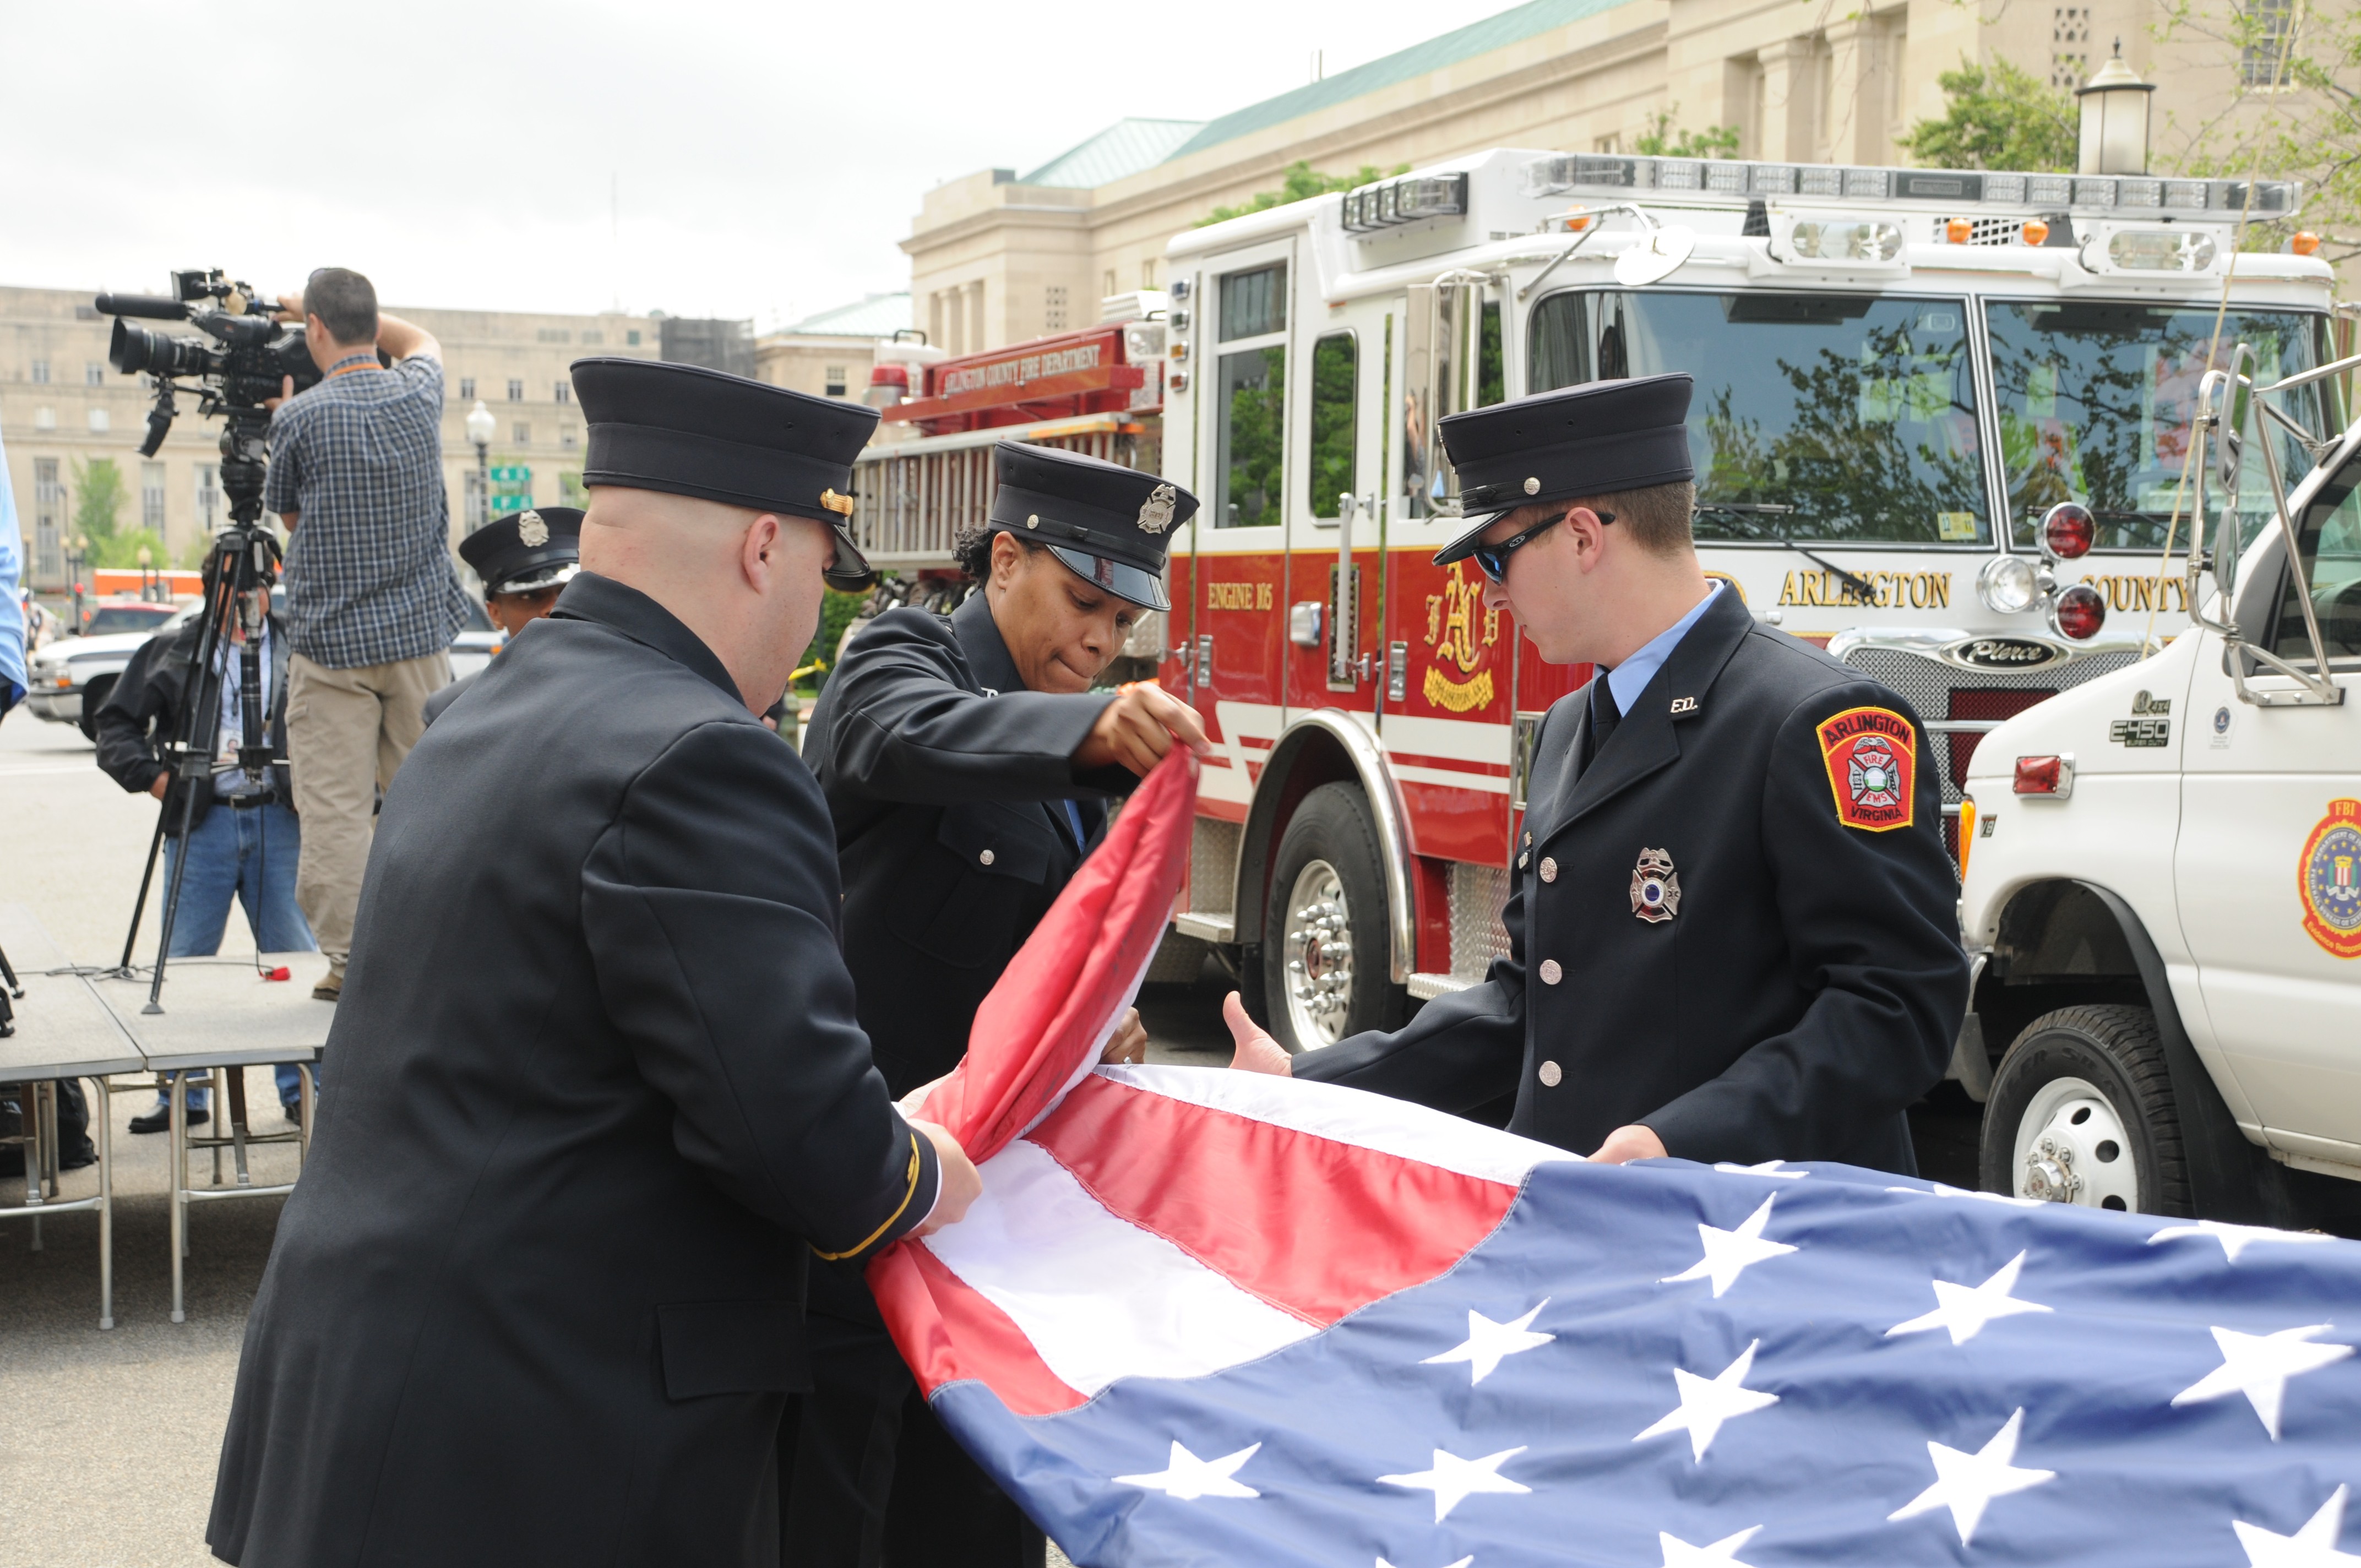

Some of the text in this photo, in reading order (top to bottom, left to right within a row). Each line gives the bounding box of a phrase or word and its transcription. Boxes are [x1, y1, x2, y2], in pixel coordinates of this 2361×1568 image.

[945, 344, 1101, 394] ARLINGTON COUNTY FIRE DEPARTMENT
[1207, 582, 1254, 611] ENGINE
[2080, 574, 2189, 612] OUNTY
[1967, 640, 2043, 662] Pierce
[1824, 714, 1911, 747] ARLINGTON
[1863, 755, 1884, 765] FIRE
[1865, 793, 1888, 803] EMS
[1851, 806, 1903, 821] VIRGINIA
[2335, 801, 2355, 816] FBI
[1981, 820, 1995, 835] V8
